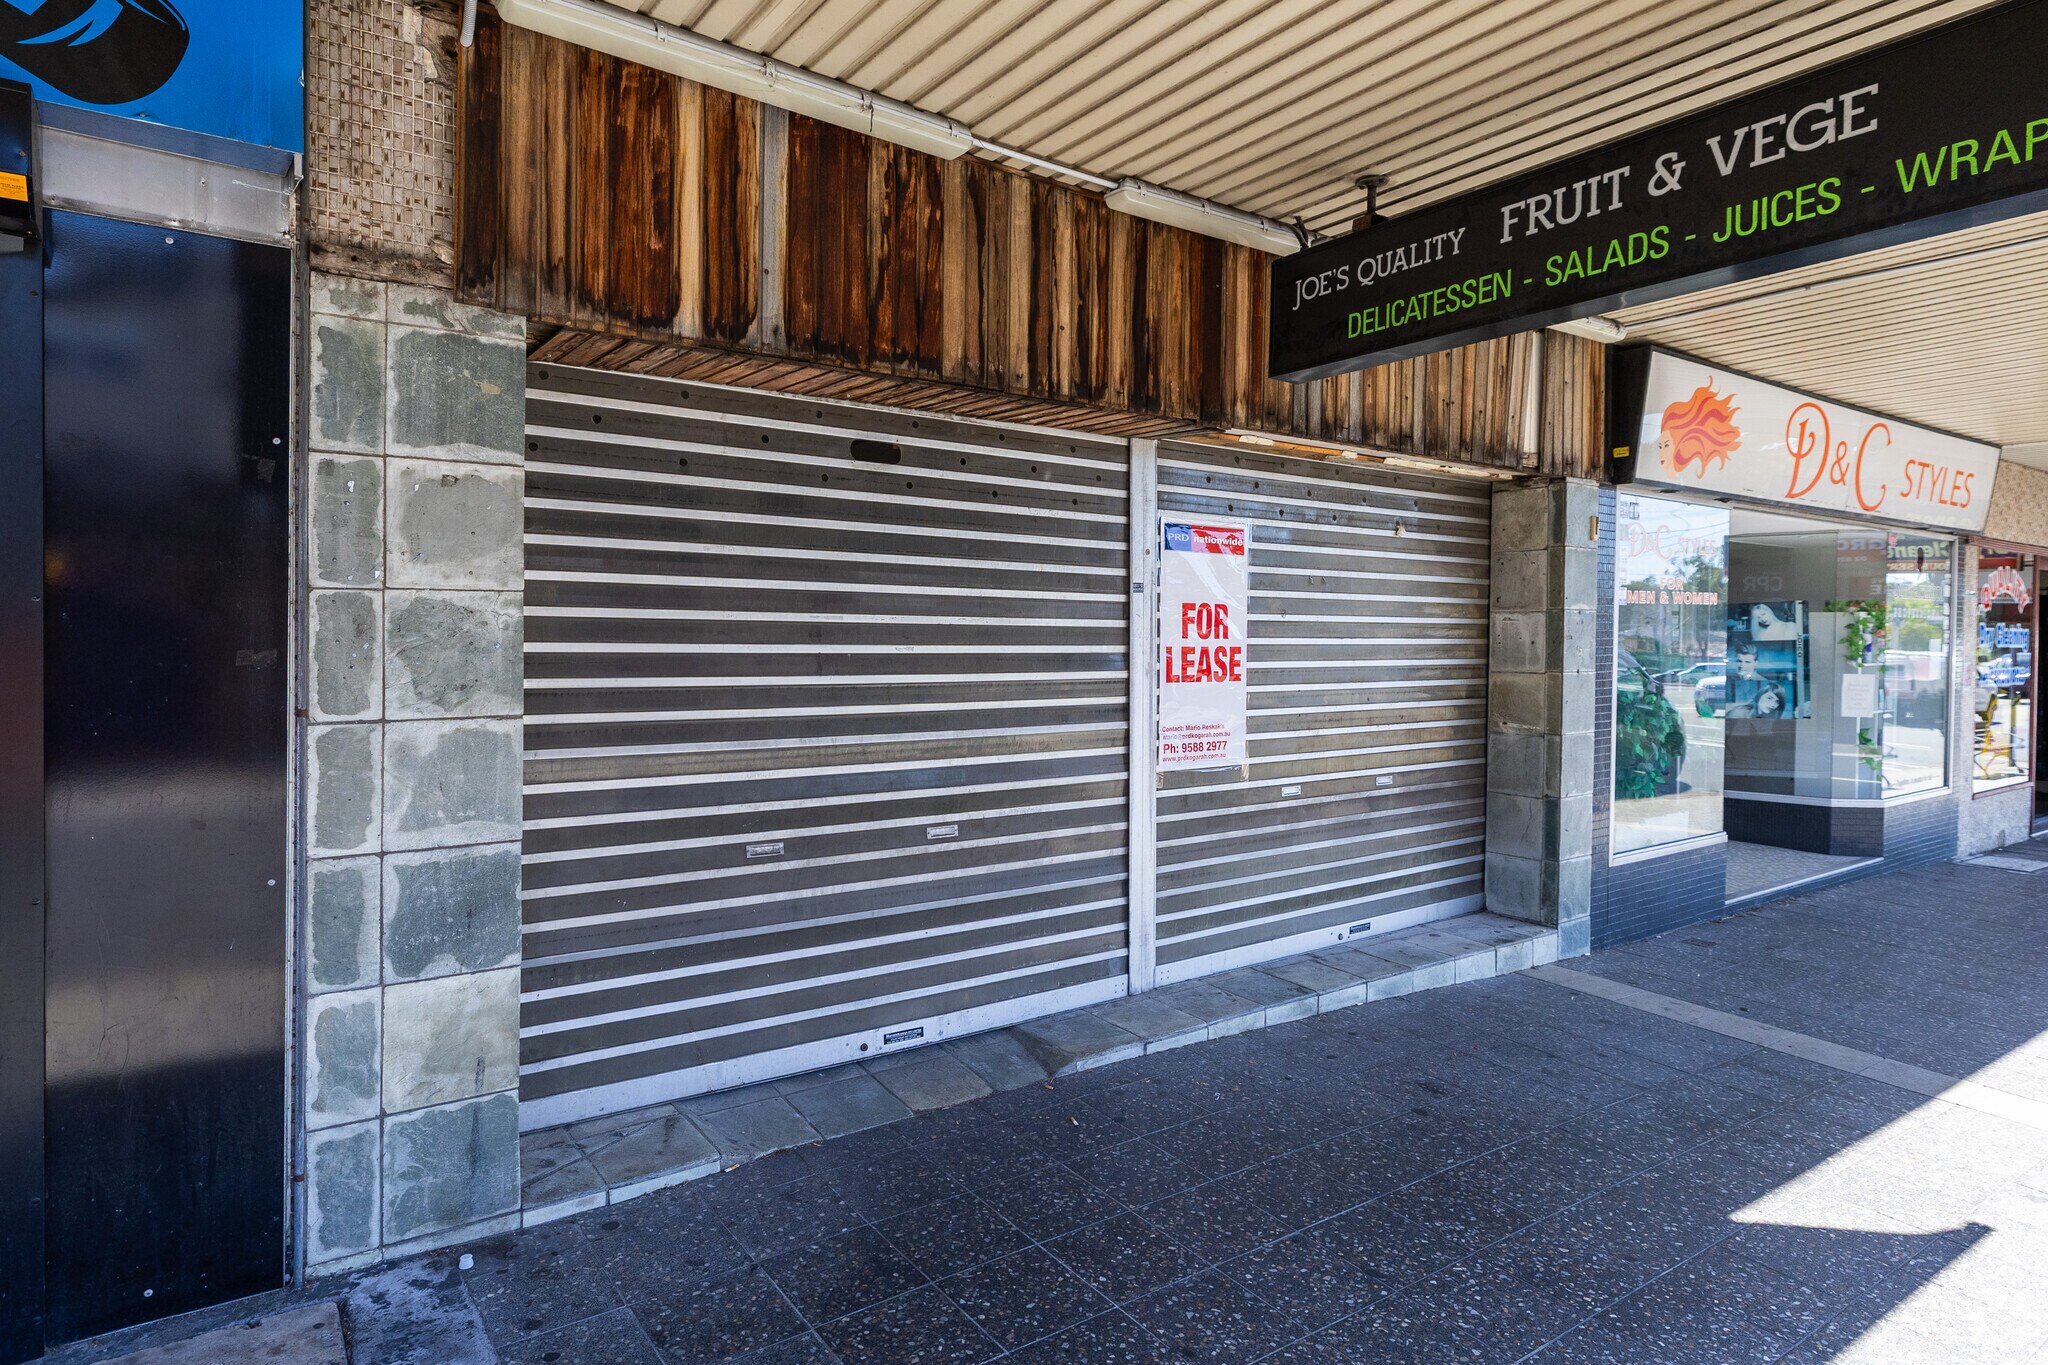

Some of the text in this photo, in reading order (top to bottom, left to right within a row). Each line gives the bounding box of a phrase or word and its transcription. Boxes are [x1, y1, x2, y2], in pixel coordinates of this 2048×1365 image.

[1292, 83, 1880, 311] JOE'S QUALITY FRUIT & VEGE
[1347, 270, 1513, 339] DELICATESSEN
[1545, 224, 1671, 287] SALADS
[1712, 176, 1842, 243] JUICES
[1895, 117, 2048, 193] WRAP
[1899, 458, 1975, 510] STYLES
[1168, 532, 1243, 546] PRD nationwide
[1627, 589, 1719, 606] MEN & WOMEN
[1659, 576, 1684, 591] FOR
[1181, 601, 1230, 641] FOR
[1994, 622, 2031, 653] Cleaning
[1165, 645, 1243, 684] LEASE
[1163, 740, 1228, 754] Ph: 9588 2977
